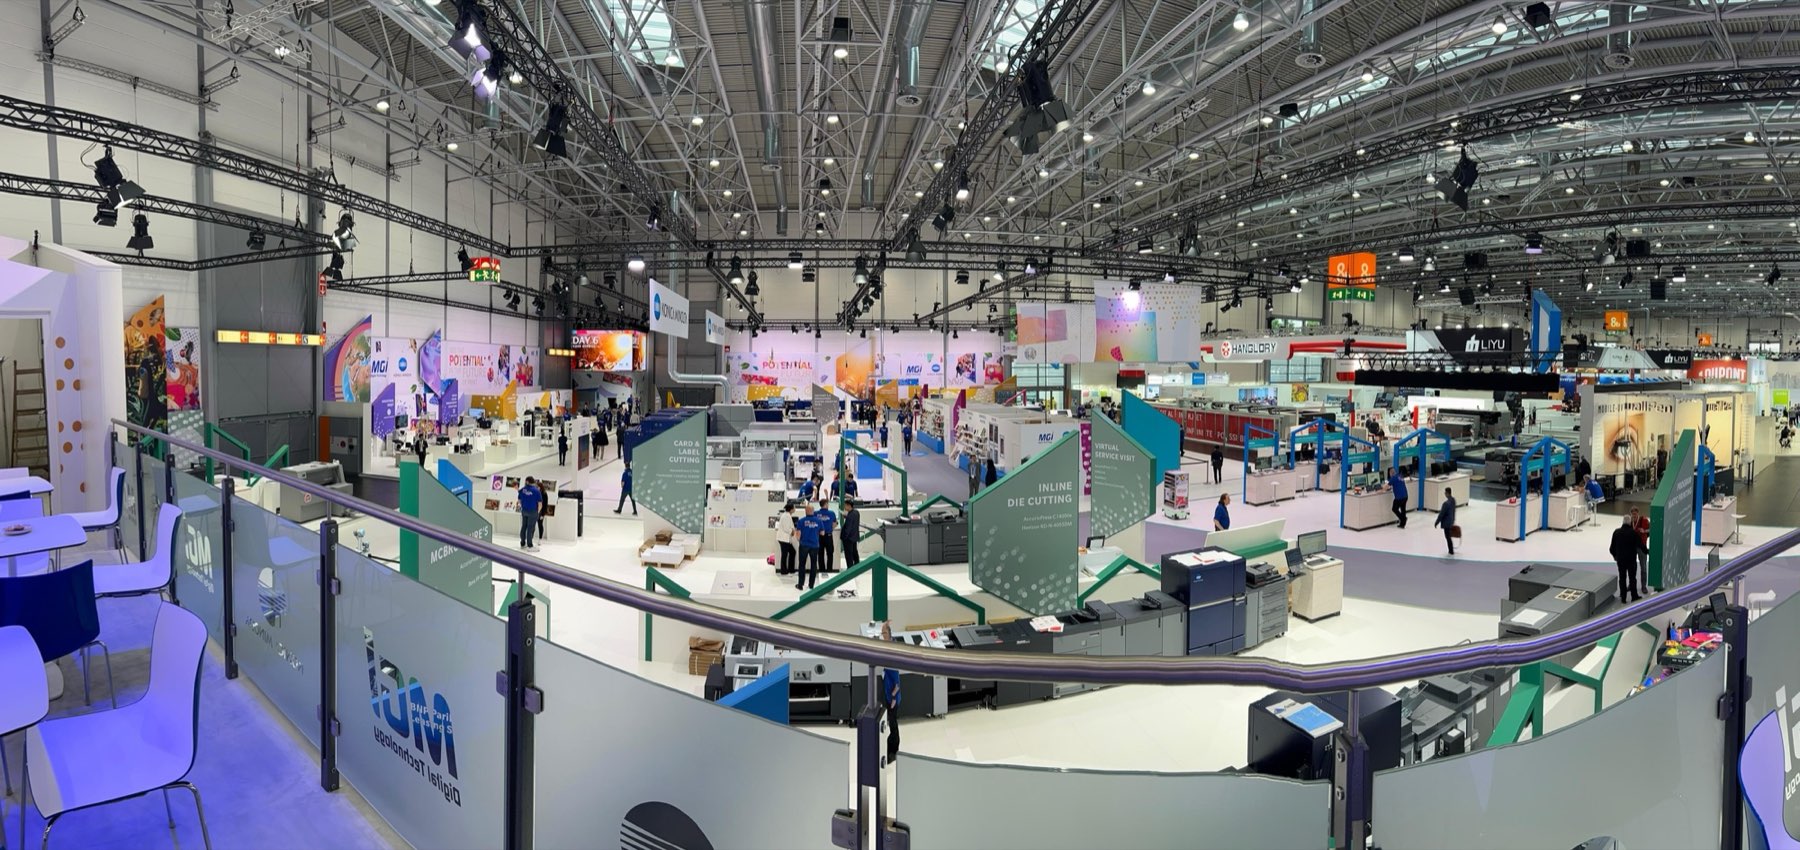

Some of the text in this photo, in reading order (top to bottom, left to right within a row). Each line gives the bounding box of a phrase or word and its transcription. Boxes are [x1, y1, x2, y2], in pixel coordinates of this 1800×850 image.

[572, 336, 599, 345] DAY 6
[1481, 339, 1506, 350] LIYU
[1231, 342, 1277, 354] HANGLORY
[1095, 443, 1119, 451] VIRTUAL
[1095, 451, 1135, 462] SERVICE VISIT
[1039, 481, 1073, 493] INLINE
[1007, 494, 1072, 507] DIE CUTTING
[411, 703, 452, 722] BNP Pari
